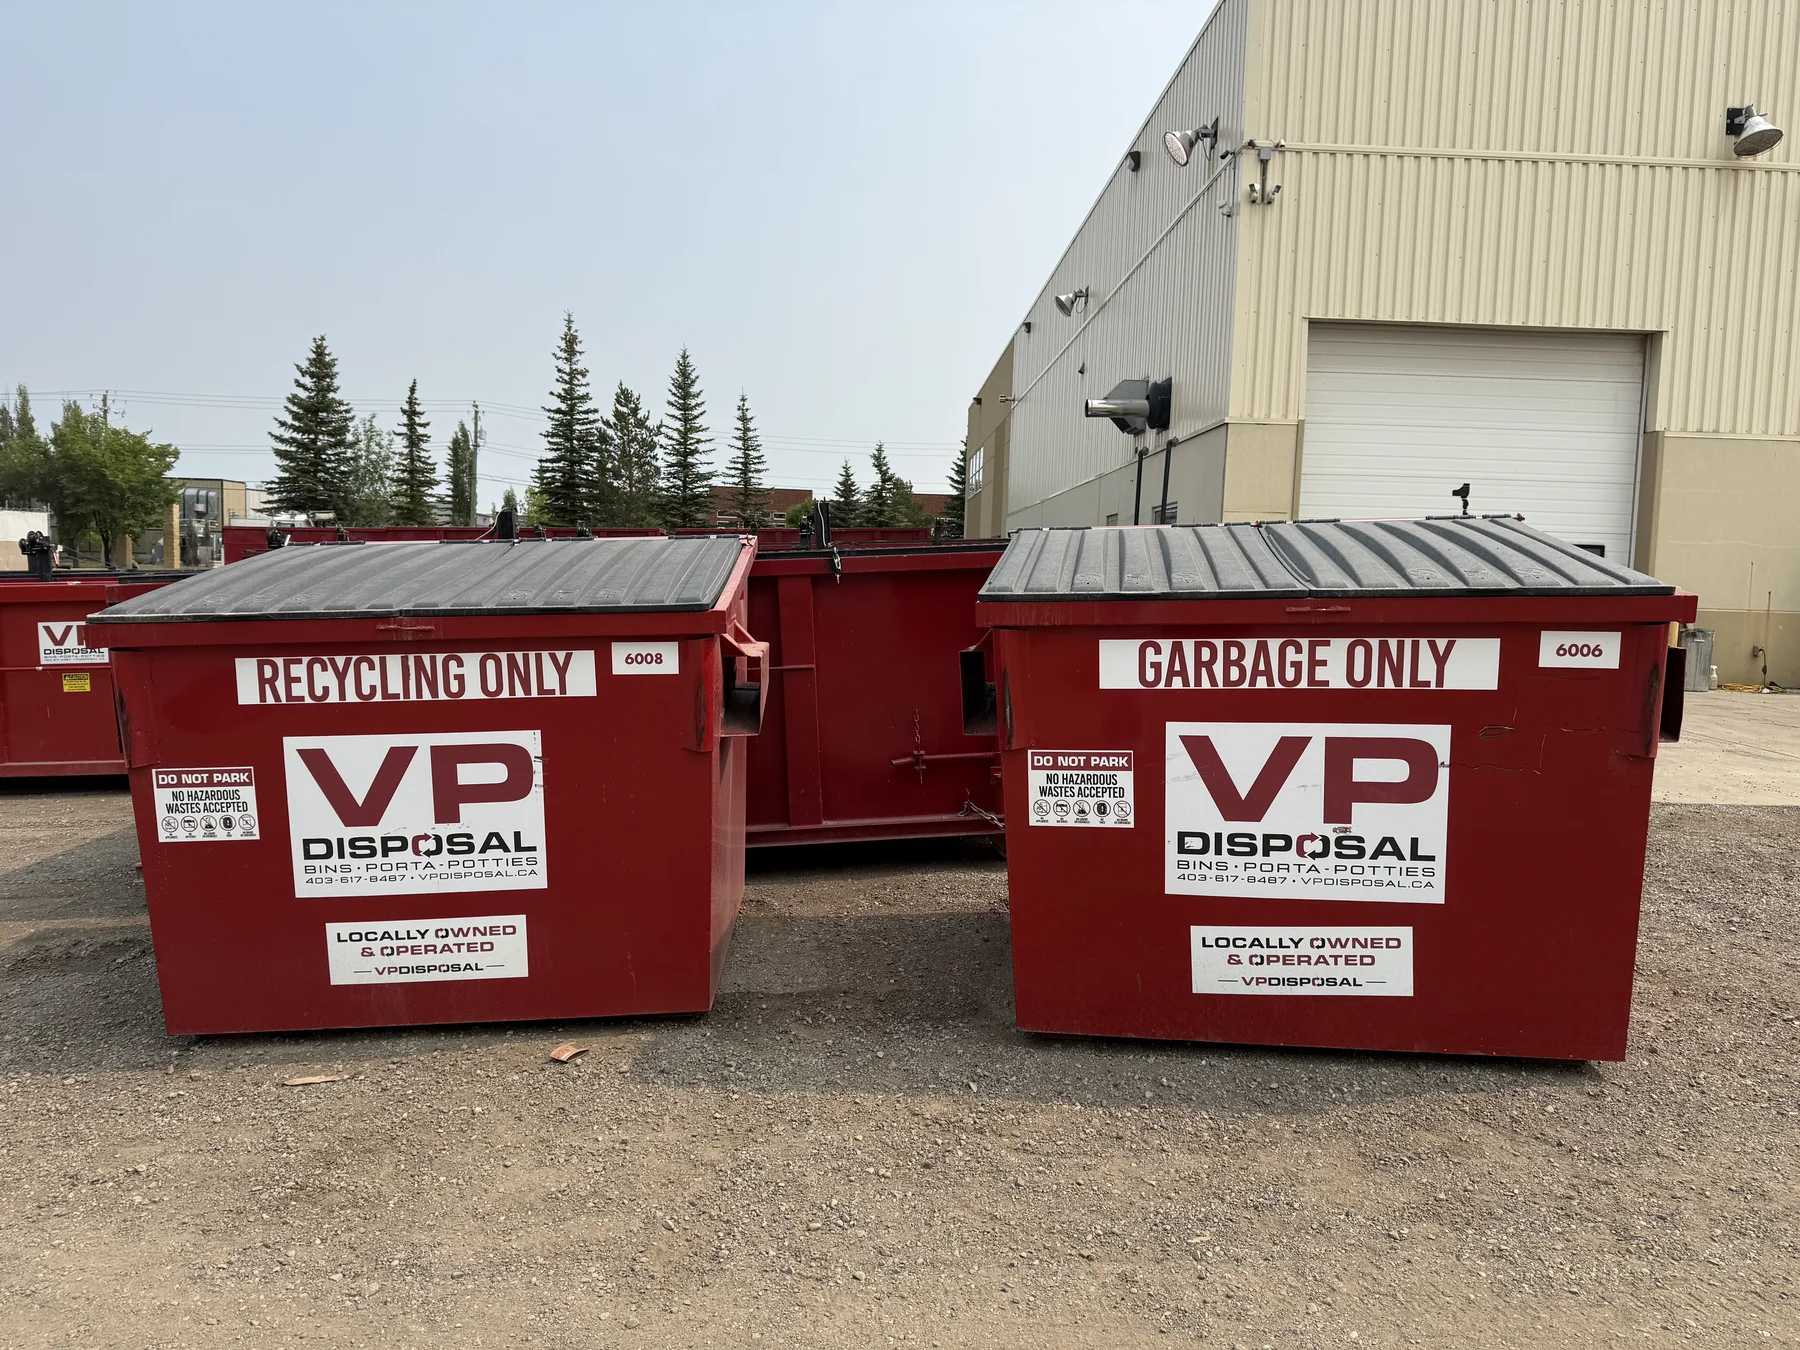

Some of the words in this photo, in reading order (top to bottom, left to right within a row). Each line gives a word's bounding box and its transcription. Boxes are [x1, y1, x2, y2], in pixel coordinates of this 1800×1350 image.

[1555, 643, 1603, 657] 6006
[624, 652, 663, 665] 6008
[1138, 639, 1330, 688] GARBAGE
[1345, 638, 1457, 689] ONLY
[256, 653, 466, 703] RECYCLING
[478, 652, 573, 697] ONLY
[1033, 756, 1053, 766] DO
[1057, 755, 1086, 767] NOT
[1091, 756, 1129, 767] PARK
[158, 774, 177, 785] DO
[181, 773, 209, 784] NOT
[213, 772, 250, 783] PARK
[295, 742, 534, 828] VP
[1046, 773, 1059, 785] NO
[1062, 773, 1118, 785] HAZARDOUS
[1178, 735, 1439, 824] VP
[172, 790, 184, 802] NO
[187, 789, 240, 802] HAZARDOUS
[1039, 786, 1075, 798] WASTES
[1077, 786, 1125, 798] ACCEPTED
[165, 802, 201, 814] WASTES
[203, 801, 248, 813] ACCEPTED
[302, 830, 537, 860] DISPOSAL
[1177, 831, 1436, 862] DISPOSAL
[304, 864, 352, 874] BINS
[1177, 860, 1229, 871] BINS
[305, 875, 406, 884] 403-617-8487
[418, 869, 538, 880] VPDISPOSAL.CA
[1177, 873, 1287, 885] 403-617-8487
[1300, 877, 1435, 889] VPDISPOSAL.CA
[337, 929, 430, 943] LOCALLY
[434, 925, 517, 939] OWNED
[361, 947, 375, 957] &
[380, 941, 495, 957] OPERATED
[1201, 937, 1304, 949] LOCALLY
[1309, 936, 1402, 950] OWNED
[1227, 954, 1243, 966] &
[1248, 953, 1376, 966] OPERATED
[374, 962, 484, 976] VPDISPOSAL
[1241, 976, 1363, 987] VPDISPOSAL
